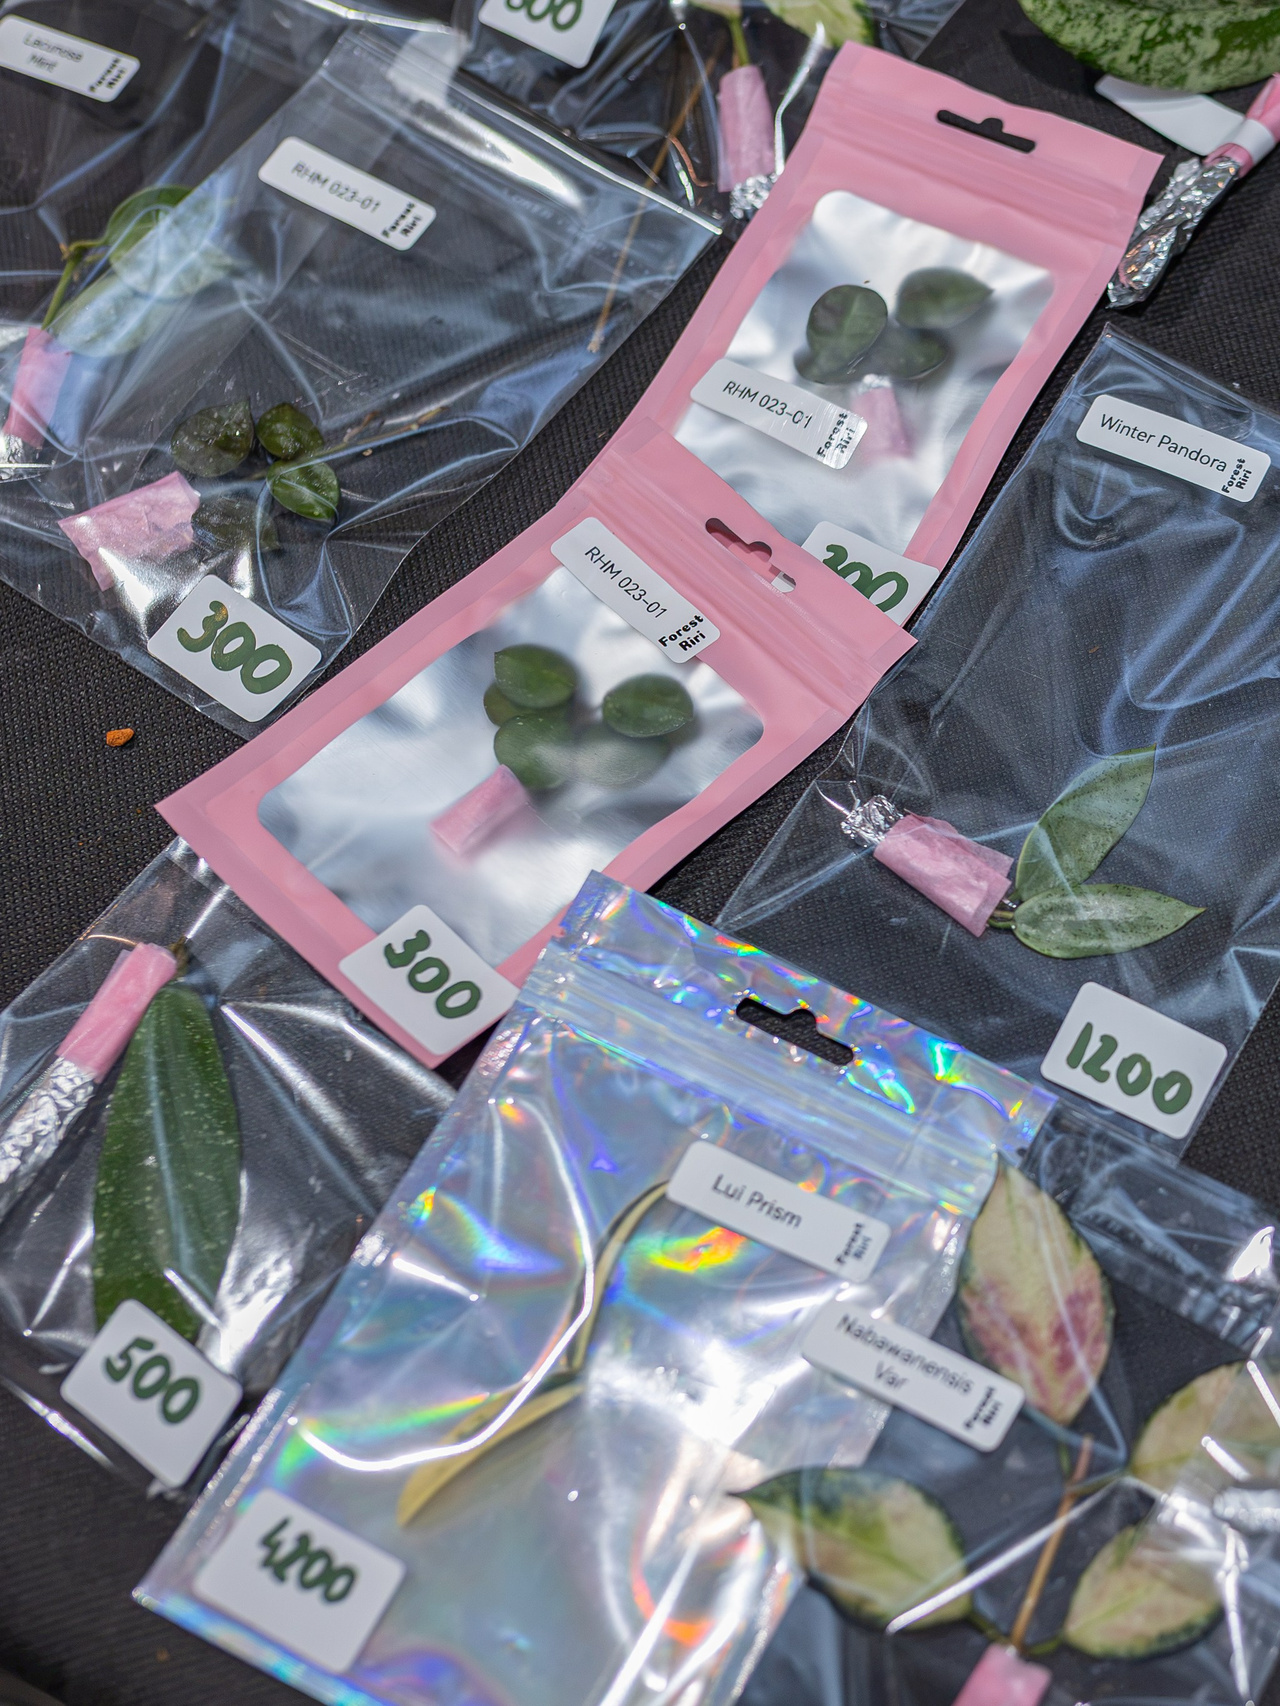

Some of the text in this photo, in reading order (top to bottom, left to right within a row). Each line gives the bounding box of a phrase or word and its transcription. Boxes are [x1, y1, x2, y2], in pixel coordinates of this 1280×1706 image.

[291, 161, 381, 213] RHM 023-01
[722, 380, 813, 430] RHM 023-01
[816, 412, 849, 458] Forest
[1100, 413, 1228, 473] Winter Pandora
[1221, 457, 1246, 494] Forest
[1235, 469, 1252, 490] Riri
[585, 546, 668, 619] RHM 023-01
[177, 600, 292, 695] 300
[658, 614, 704, 648] Forest
[678, 630, 706, 651] Riri
[383, 929, 482, 1019] 300
[1065, 1021, 1193, 1115] 1200
[711, 1173, 803, 1229] Lui Prism
[105, 1336, 201, 1425] 500
[835, 1313, 976, 1396] Nabawanensis
[873, 1360, 909, 1391] Var
